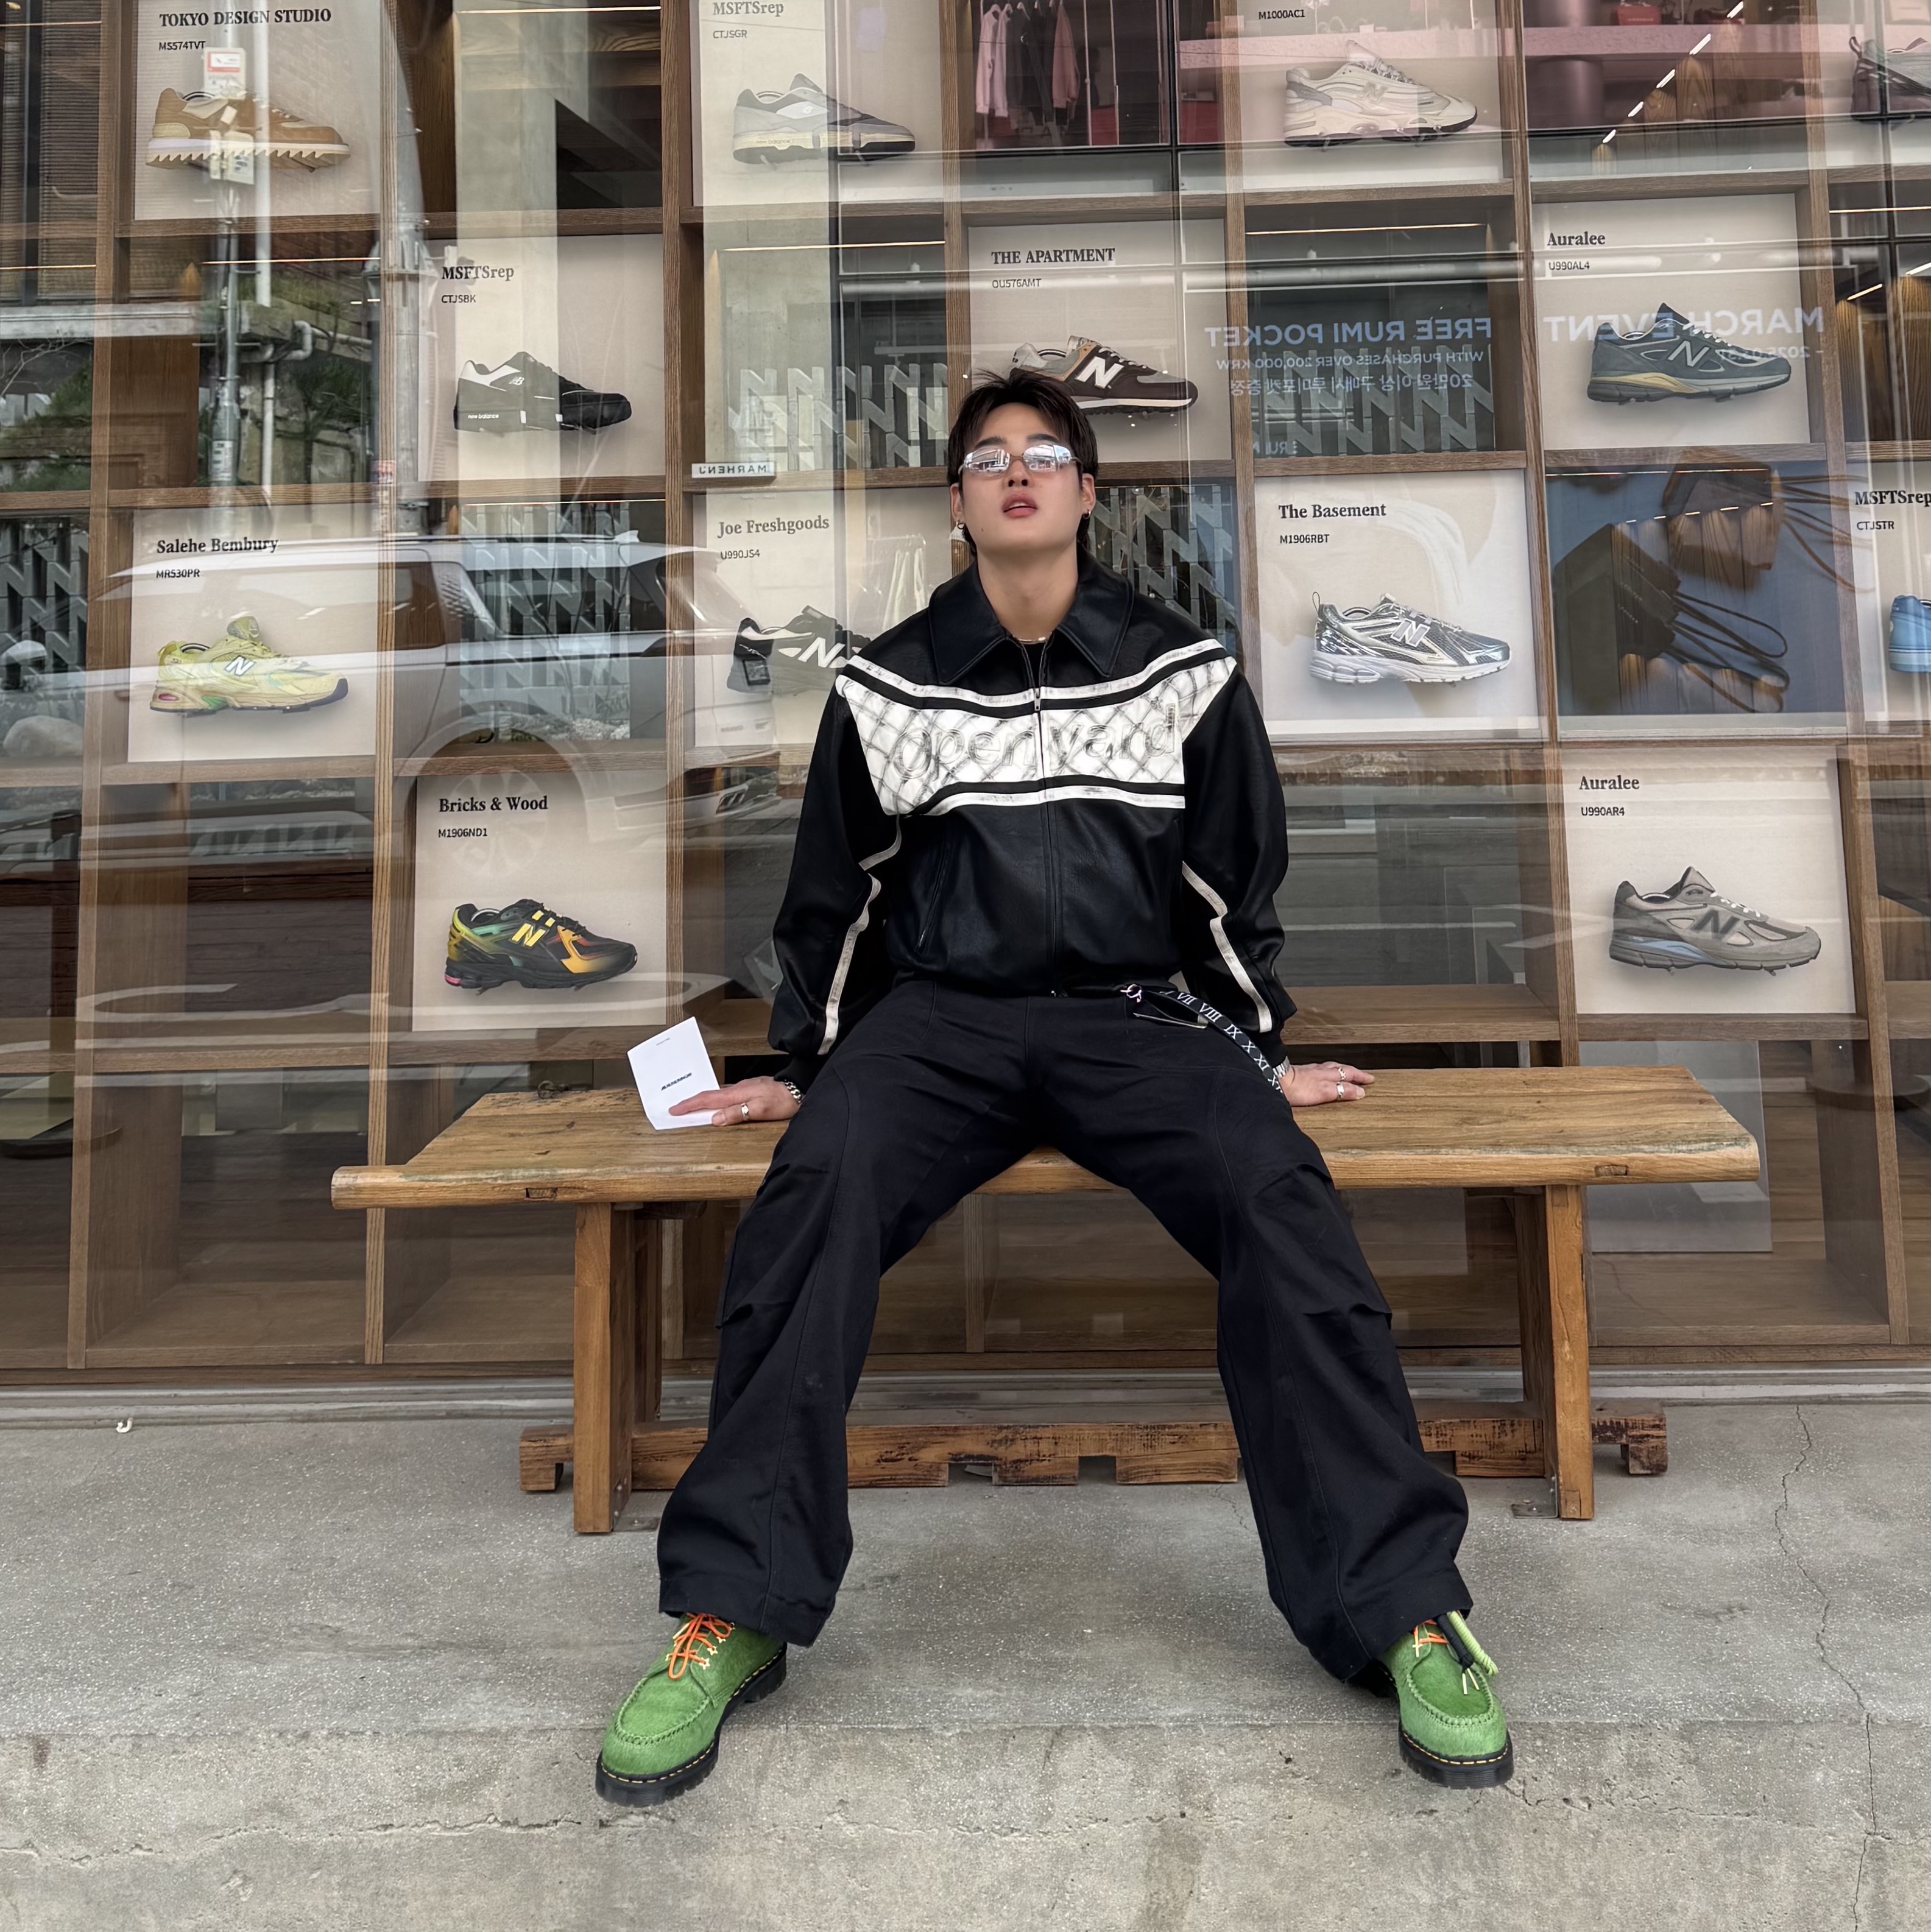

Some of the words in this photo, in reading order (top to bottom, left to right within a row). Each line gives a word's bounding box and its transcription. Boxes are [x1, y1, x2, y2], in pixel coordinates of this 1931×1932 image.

[713, 1, 784, 17] MSFTSrep
[1259, 9, 1305, 20] M1000AC1
[159, 12, 209, 27] TOKYO
[213, 10, 270, 25] DESIGN
[274, 9, 331, 23] STUDIO
[713, 29, 747, 39] CTJSGR
[158, 41, 206, 51] MS574TVT
[1547, 231, 1606, 246] Auralee
[991, 250, 1022, 264] THE
[1026, 247, 1115, 263] APARTMENT
[442, 265, 515, 281] MSFTSrep
[1548, 261, 1590, 270] U990AL4
[992, 278, 1042, 289] OU576AMT
[1668, 340, 1710, 367] N
[1075, 356, 1124, 389] N
[1854, 490, 1931, 507] MSFTSrep
[1278, 504, 1308, 519] The
[1311, 503, 1386, 518] Basement
[717, 521, 742, 539] Joe
[746, 515, 830, 534] Freshgoods
[1857, 520, 1894, 530] CTJSTR
[157, 538, 206, 554] Salehe
[211, 537, 278, 553] Bembury
[1280, 534, 1330, 544] M1906RBT
[721, 549, 760, 560] U990JS4
[156, 568, 200, 579] MR530PR
[1390, 618, 1431, 647] N
[798, 637, 845, 668] N
[224, 655, 256, 676] N
[1579, 775, 1640, 790] Auralee
[439, 797, 486, 812] Bricks
[490, 797, 503, 811] &
[506, 795, 549, 811] Wood
[1581, 806, 1625, 816] U990AR4
[438, 828, 488, 838] M1906ND1
[1690, 908, 1740, 941] N
[509, 922, 548, 948] N
[1176, 992, 1199, 1006] VII
[1199, 1002, 1224, 1023] VIII
[1223, 1023, 1243, 1040] IX
[1241, 1040, 1257, 1054] X
[1253, 1054, 1270, 1072] XI
